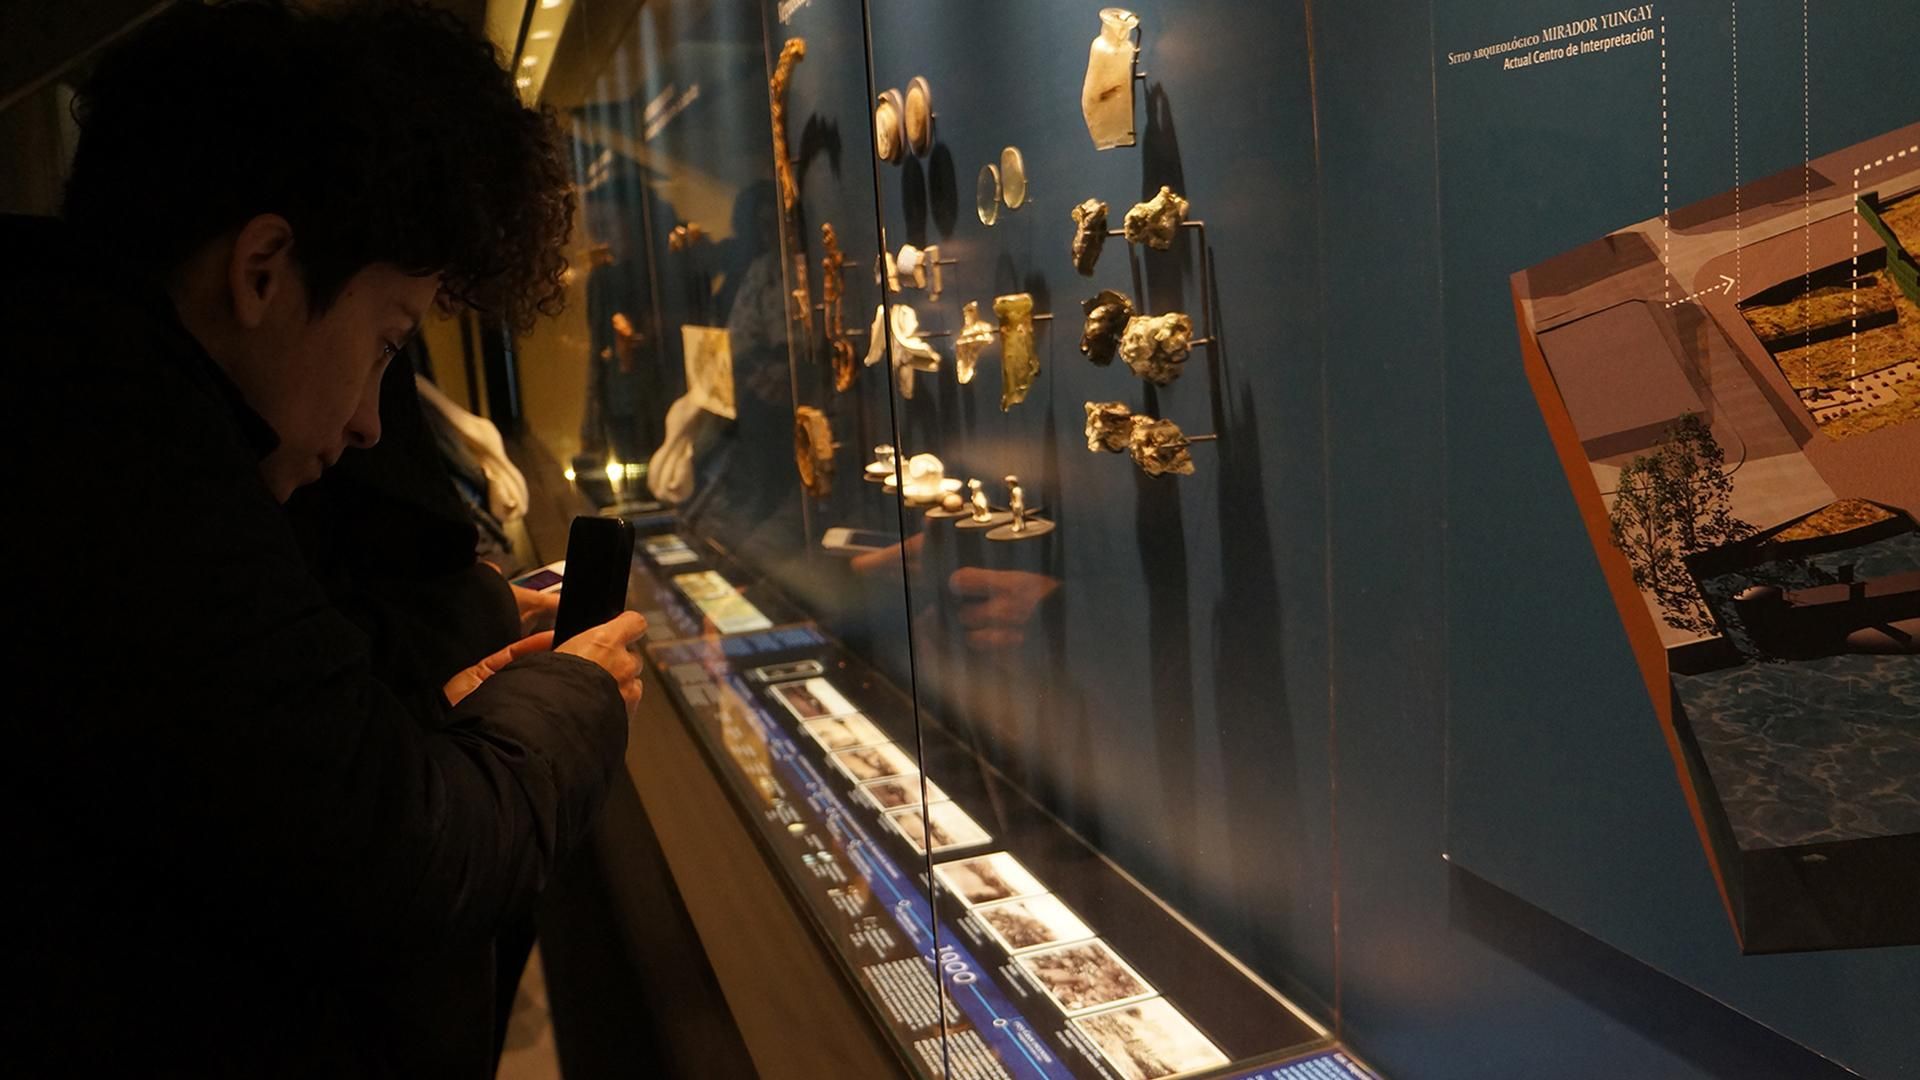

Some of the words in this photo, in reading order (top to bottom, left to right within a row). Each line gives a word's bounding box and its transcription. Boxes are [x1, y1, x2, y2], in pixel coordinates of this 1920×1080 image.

[1472, 35, 1540, 59] ARQUEOLÓGICO
[1541, 17, 1598, 43] MIRADOR
[1600, 3, 1654, 29] YUNGAY
[1503, 52, 1532, 70] Actual
[1533, 47, 1564, 64] Centro
[1565, 43, 1579, 57] de
[1580, 26, 1655, 54] Interpretación
